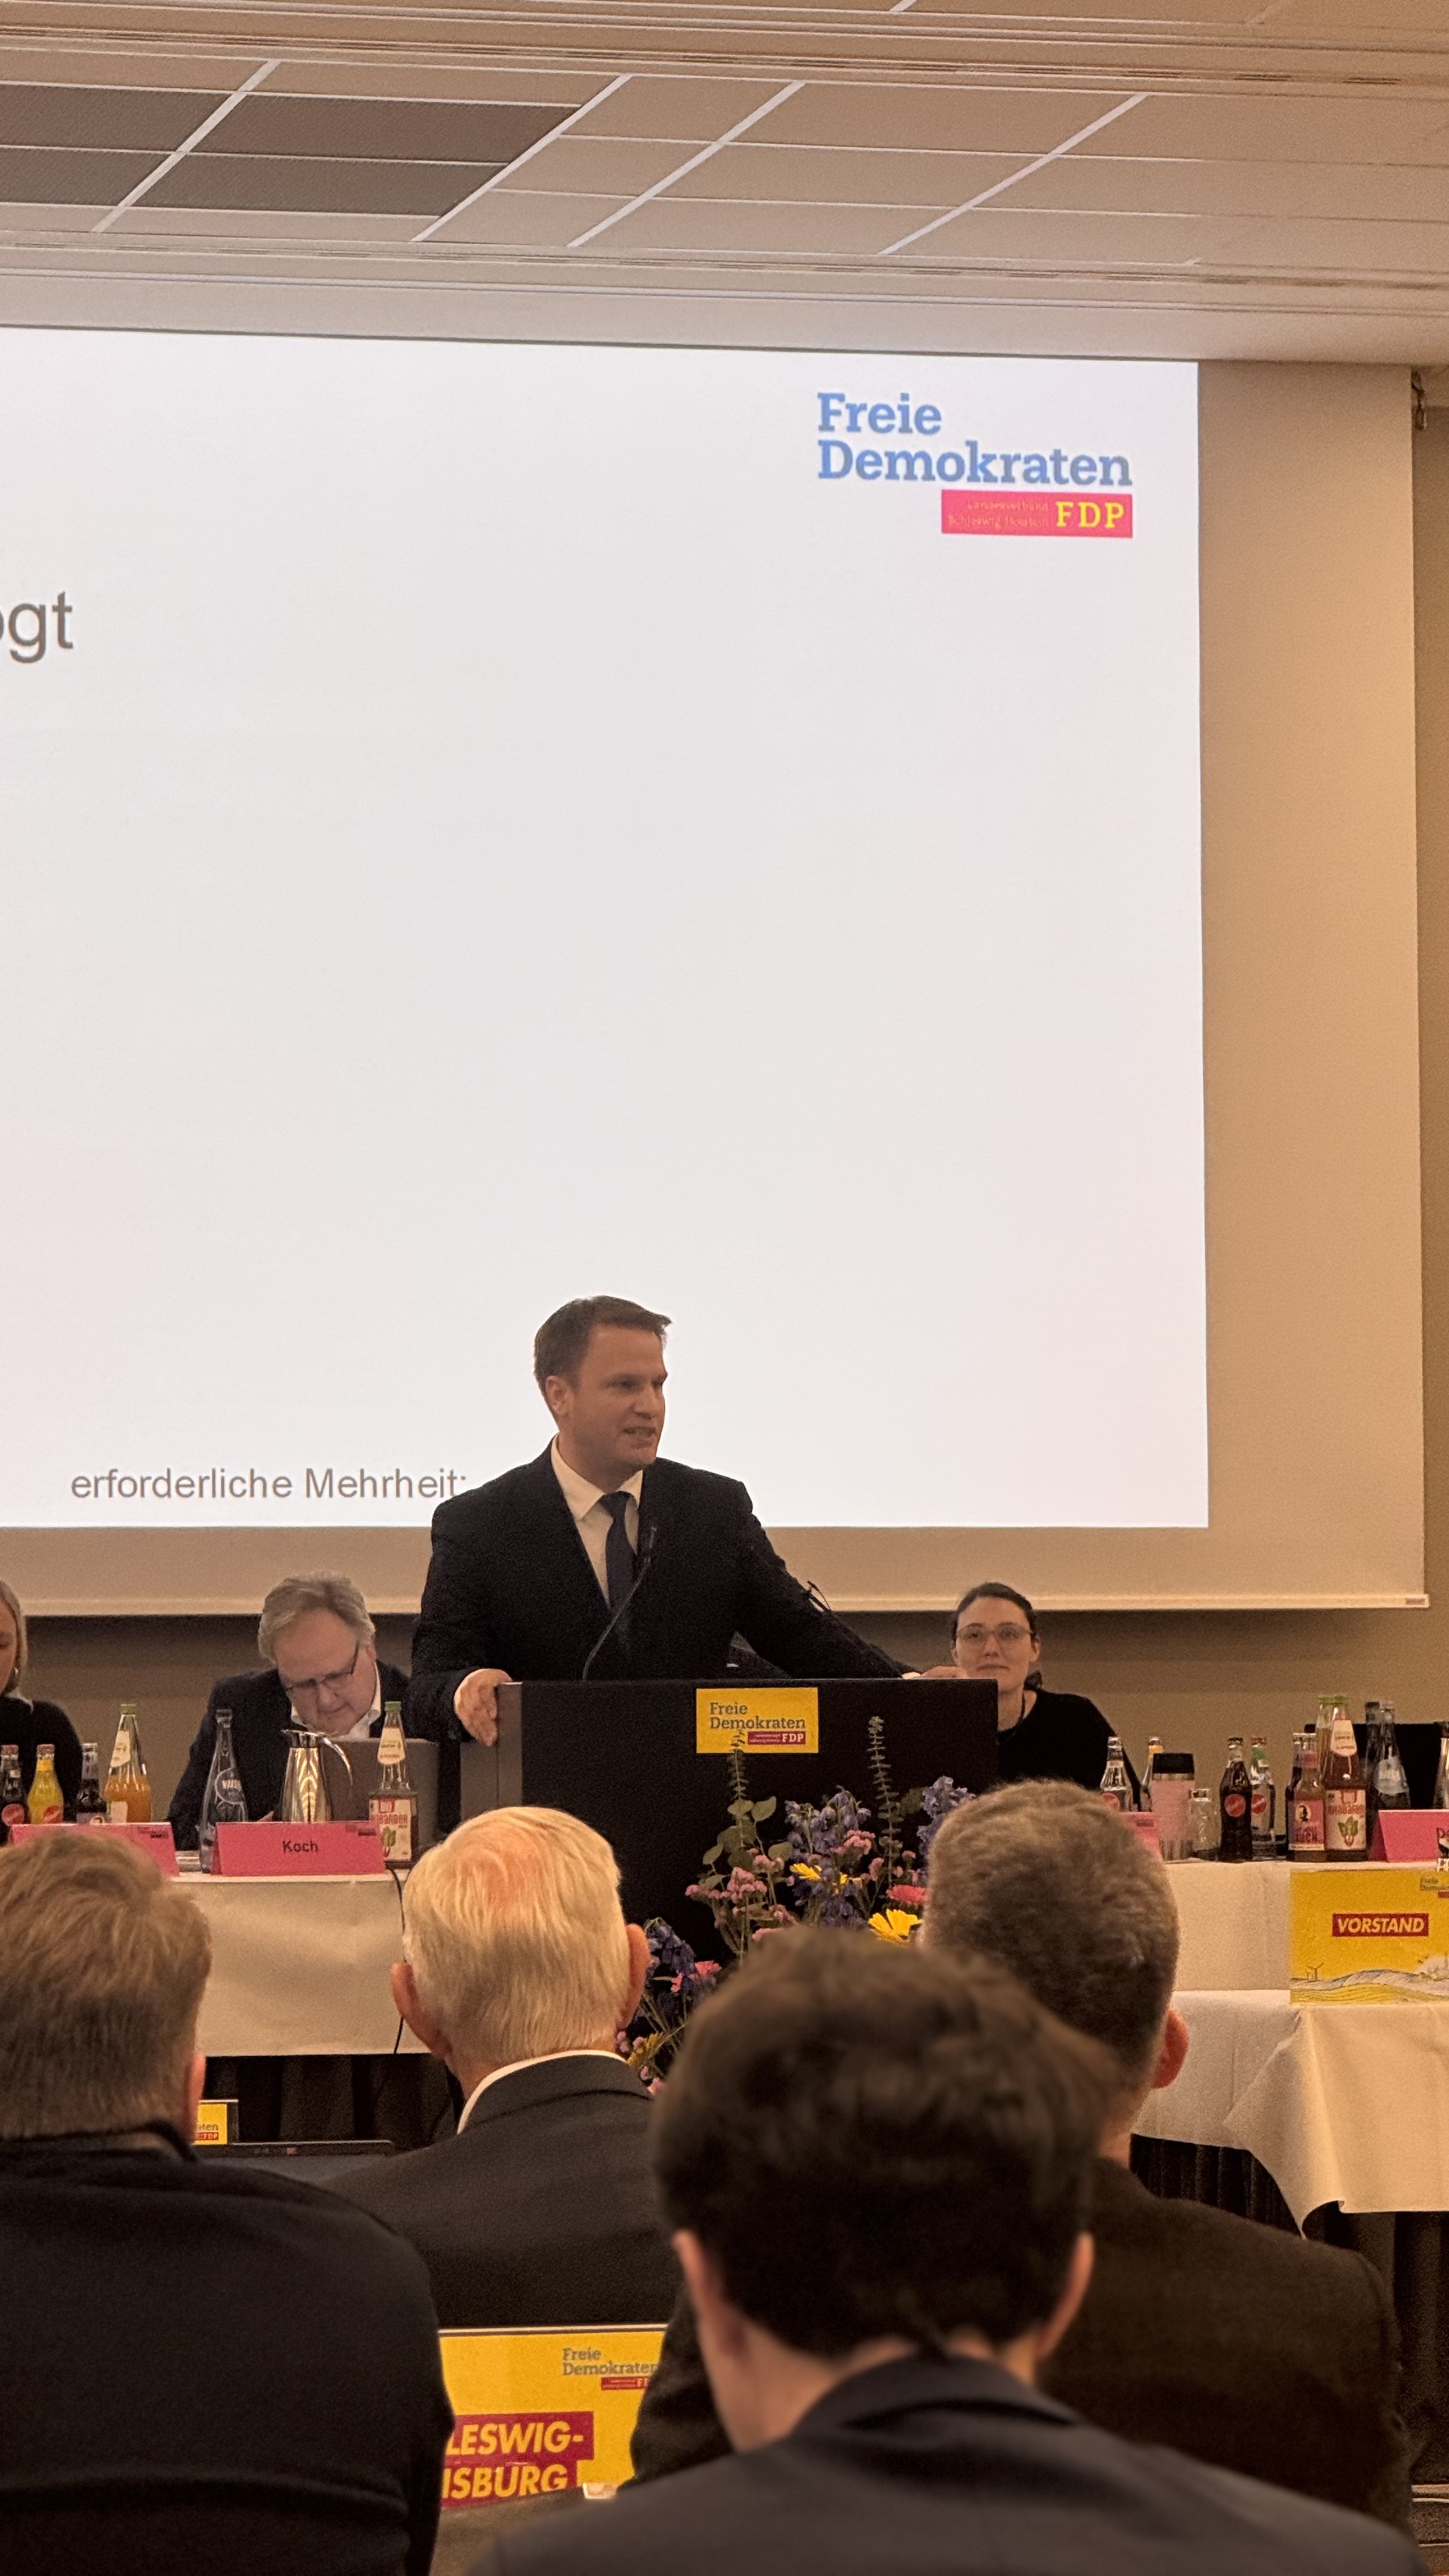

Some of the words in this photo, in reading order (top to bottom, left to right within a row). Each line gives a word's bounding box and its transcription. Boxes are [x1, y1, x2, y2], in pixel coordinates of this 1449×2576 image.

[818, 392, 942, 434] Freie
[818, 440, 1133, 486] Demokraten
[1055, 501, 1125, 529] FDP
[0, 590, 73, 664] gt
[71, 1468, 293, 1499] erforderliche
[710, 1702, 748, 1715] Freie
[710, 1715, 806, 1729] Demokraten
[781, 1733, 804, 1742] FDP
[282, 1840, 319, 1853] Koch
[1337, 1917, 1425, 1933] VORSTAND
[563, 2347, 602, 2361] Freie
